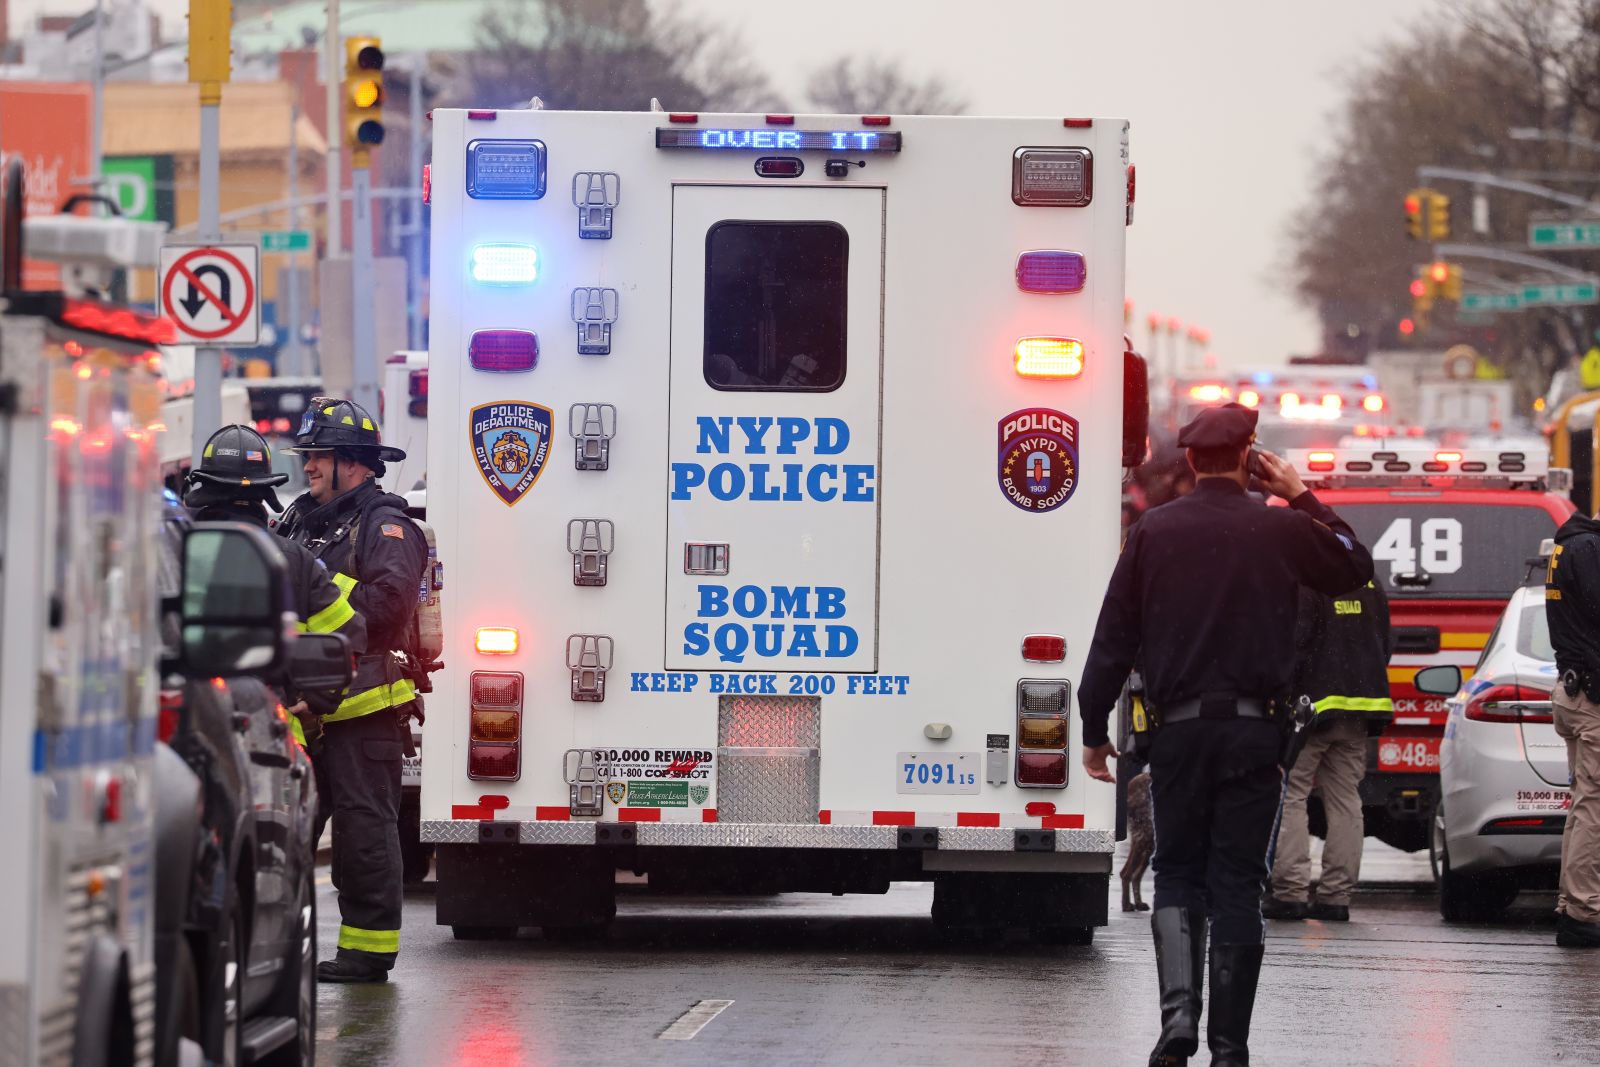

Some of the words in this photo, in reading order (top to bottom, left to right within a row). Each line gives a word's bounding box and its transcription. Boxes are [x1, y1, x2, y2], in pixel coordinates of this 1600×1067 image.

[702, 129, 803, 149] OVER
[832, 132, 876, 150] IT
[490, 405, 534, 419] POLICE
[475, 416, 548, 435] DEPARTMENT
[696, 416, 850, 455] NYPD
[1003, 413, 1074, 442] POLICE
[1020, 438, 1058, 453] NYPD
[476, 446, 491, 471] CITY
[488, 474, 502, 488] OF
[516, 471, 535, 493] NEW
[532, 441, 548, 468] YORK
[671, 462, 875, 503] POLICE
[1003, 477, 1032, 508] BOMB
[1037, 478, 1073, 509] SQUAD
[1030, 485, 1047, 493] 1903
[1372, 518, 1463, 574] 48
[697, 584, 847, 619] BOMB
[1334, 600, 1362, 614] SQUAD
[683, 622, 859, 663] SQUAD
[630, 672, 698, 692] KEEP
[710, 673, 777, 693] BACK
[789, 674, 836, 695] 200
[846, 675, 910, 695] FEET
[1394, 699, 1418, 713] CK
[1424, 699, 1442, 713] 20
[595, 749, 650, 763] $10,000
[654, 750, 713, 763] REWARD
[1402, 743, 1427, 766] 48
[598, 768, 617, 778] CALL
[620, 768, 642, 778] 1-800
[904, 763, 955, 784] 7091
[1517, 791, 1551, 802] $10,000
